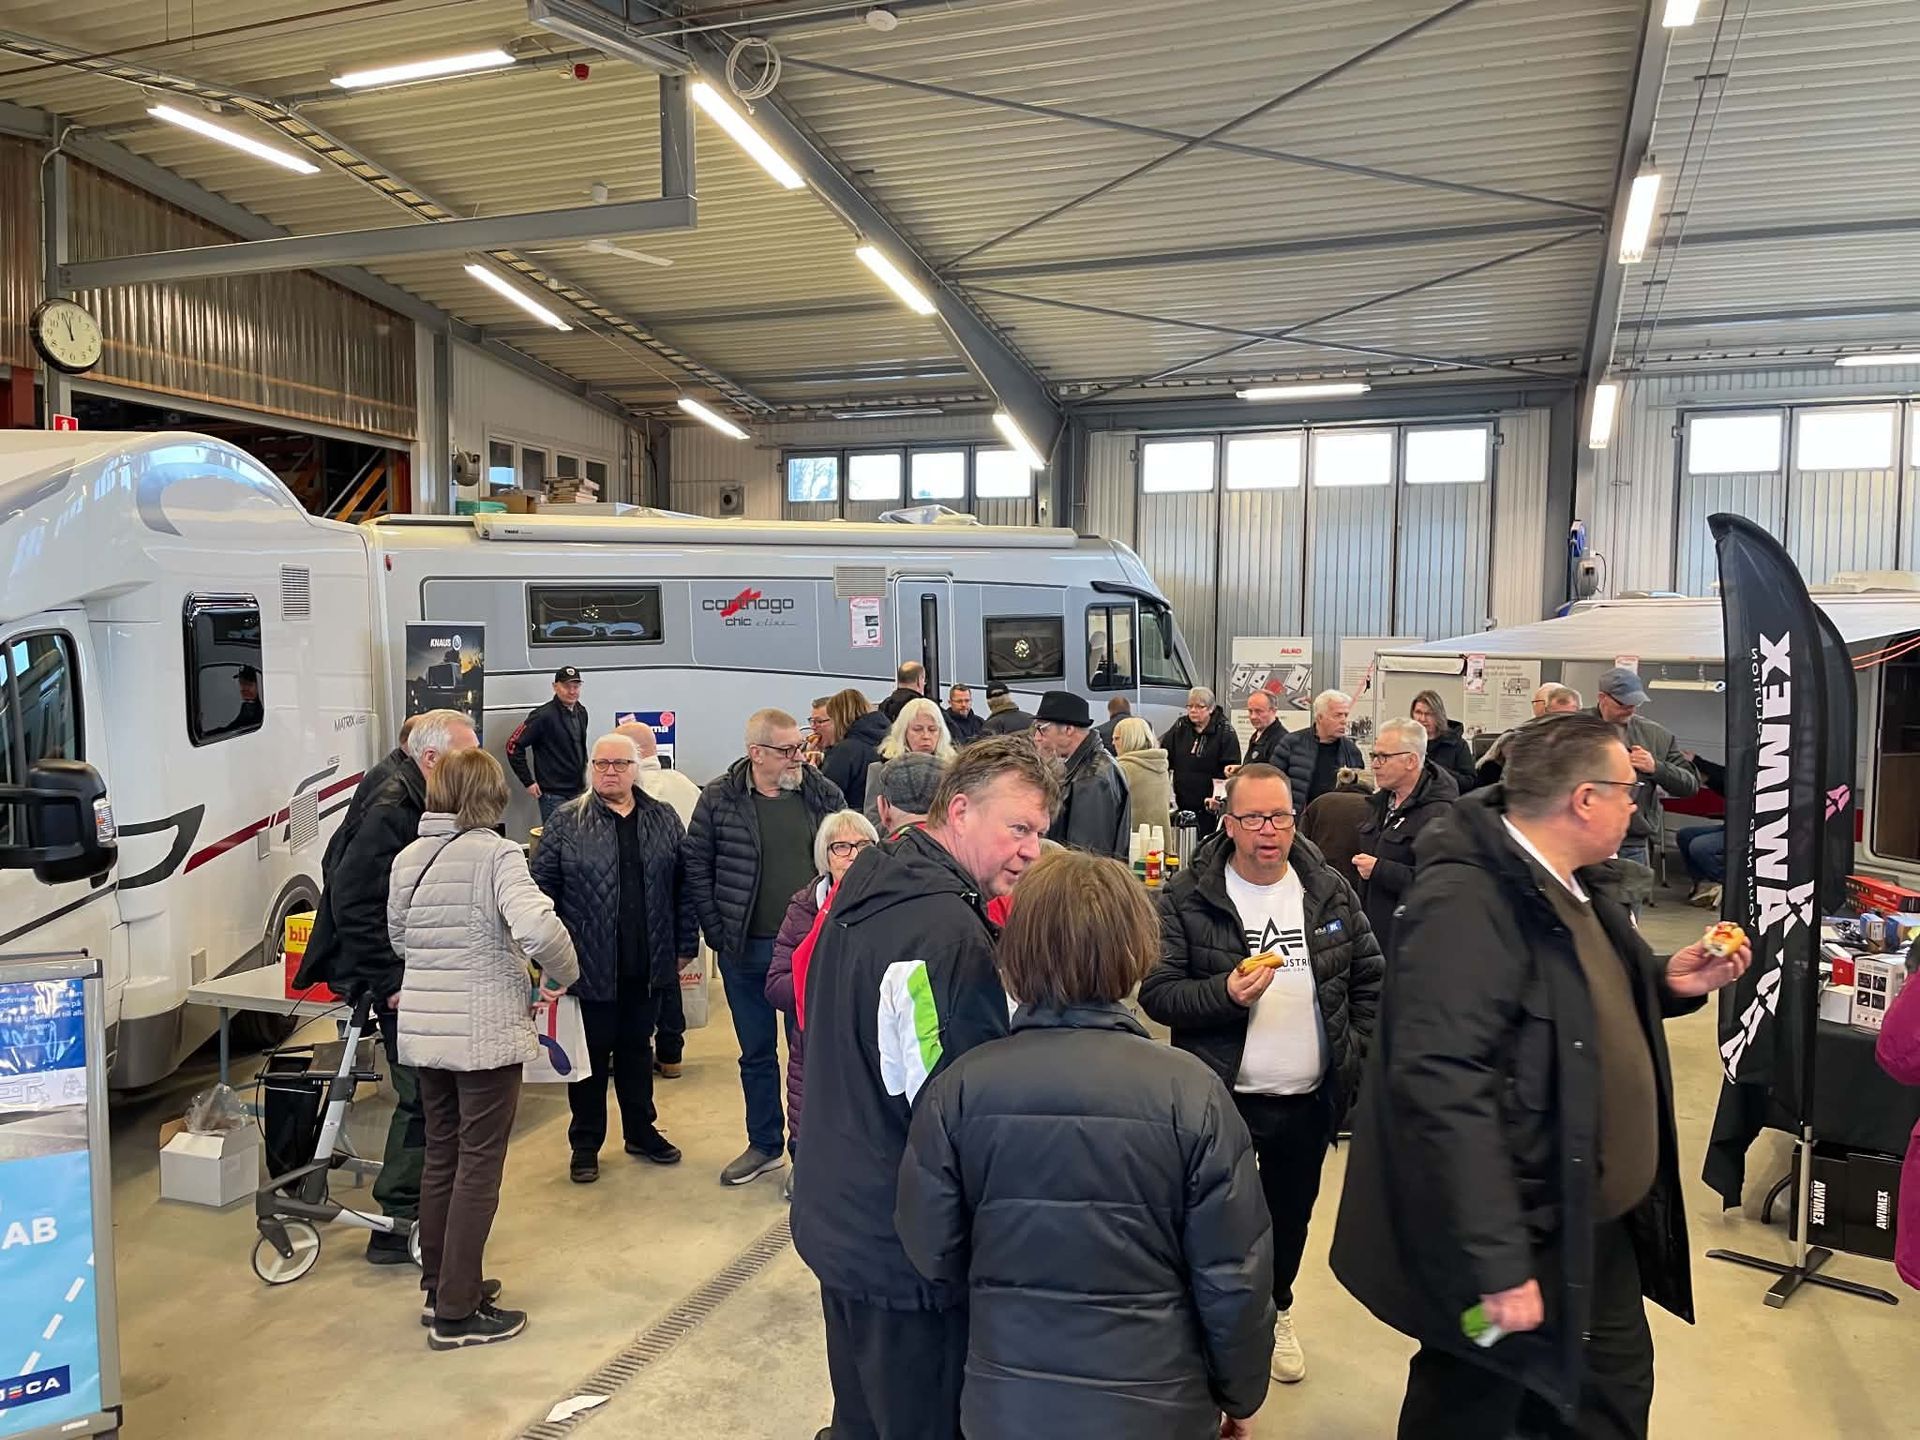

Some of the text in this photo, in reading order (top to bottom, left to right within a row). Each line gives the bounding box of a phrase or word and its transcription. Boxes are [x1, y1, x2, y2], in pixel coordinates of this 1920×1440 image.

[725, 616, 751, 626] chic
[430, 638, 452, 648] KNAUS
[289, 925, 312, 943] bil
[1812, 1180, 1826, 1227] AWIMEX
[1875, 1189, 1889, 1231] AWIMEX
[1, 1216, 59, 1250] AB
